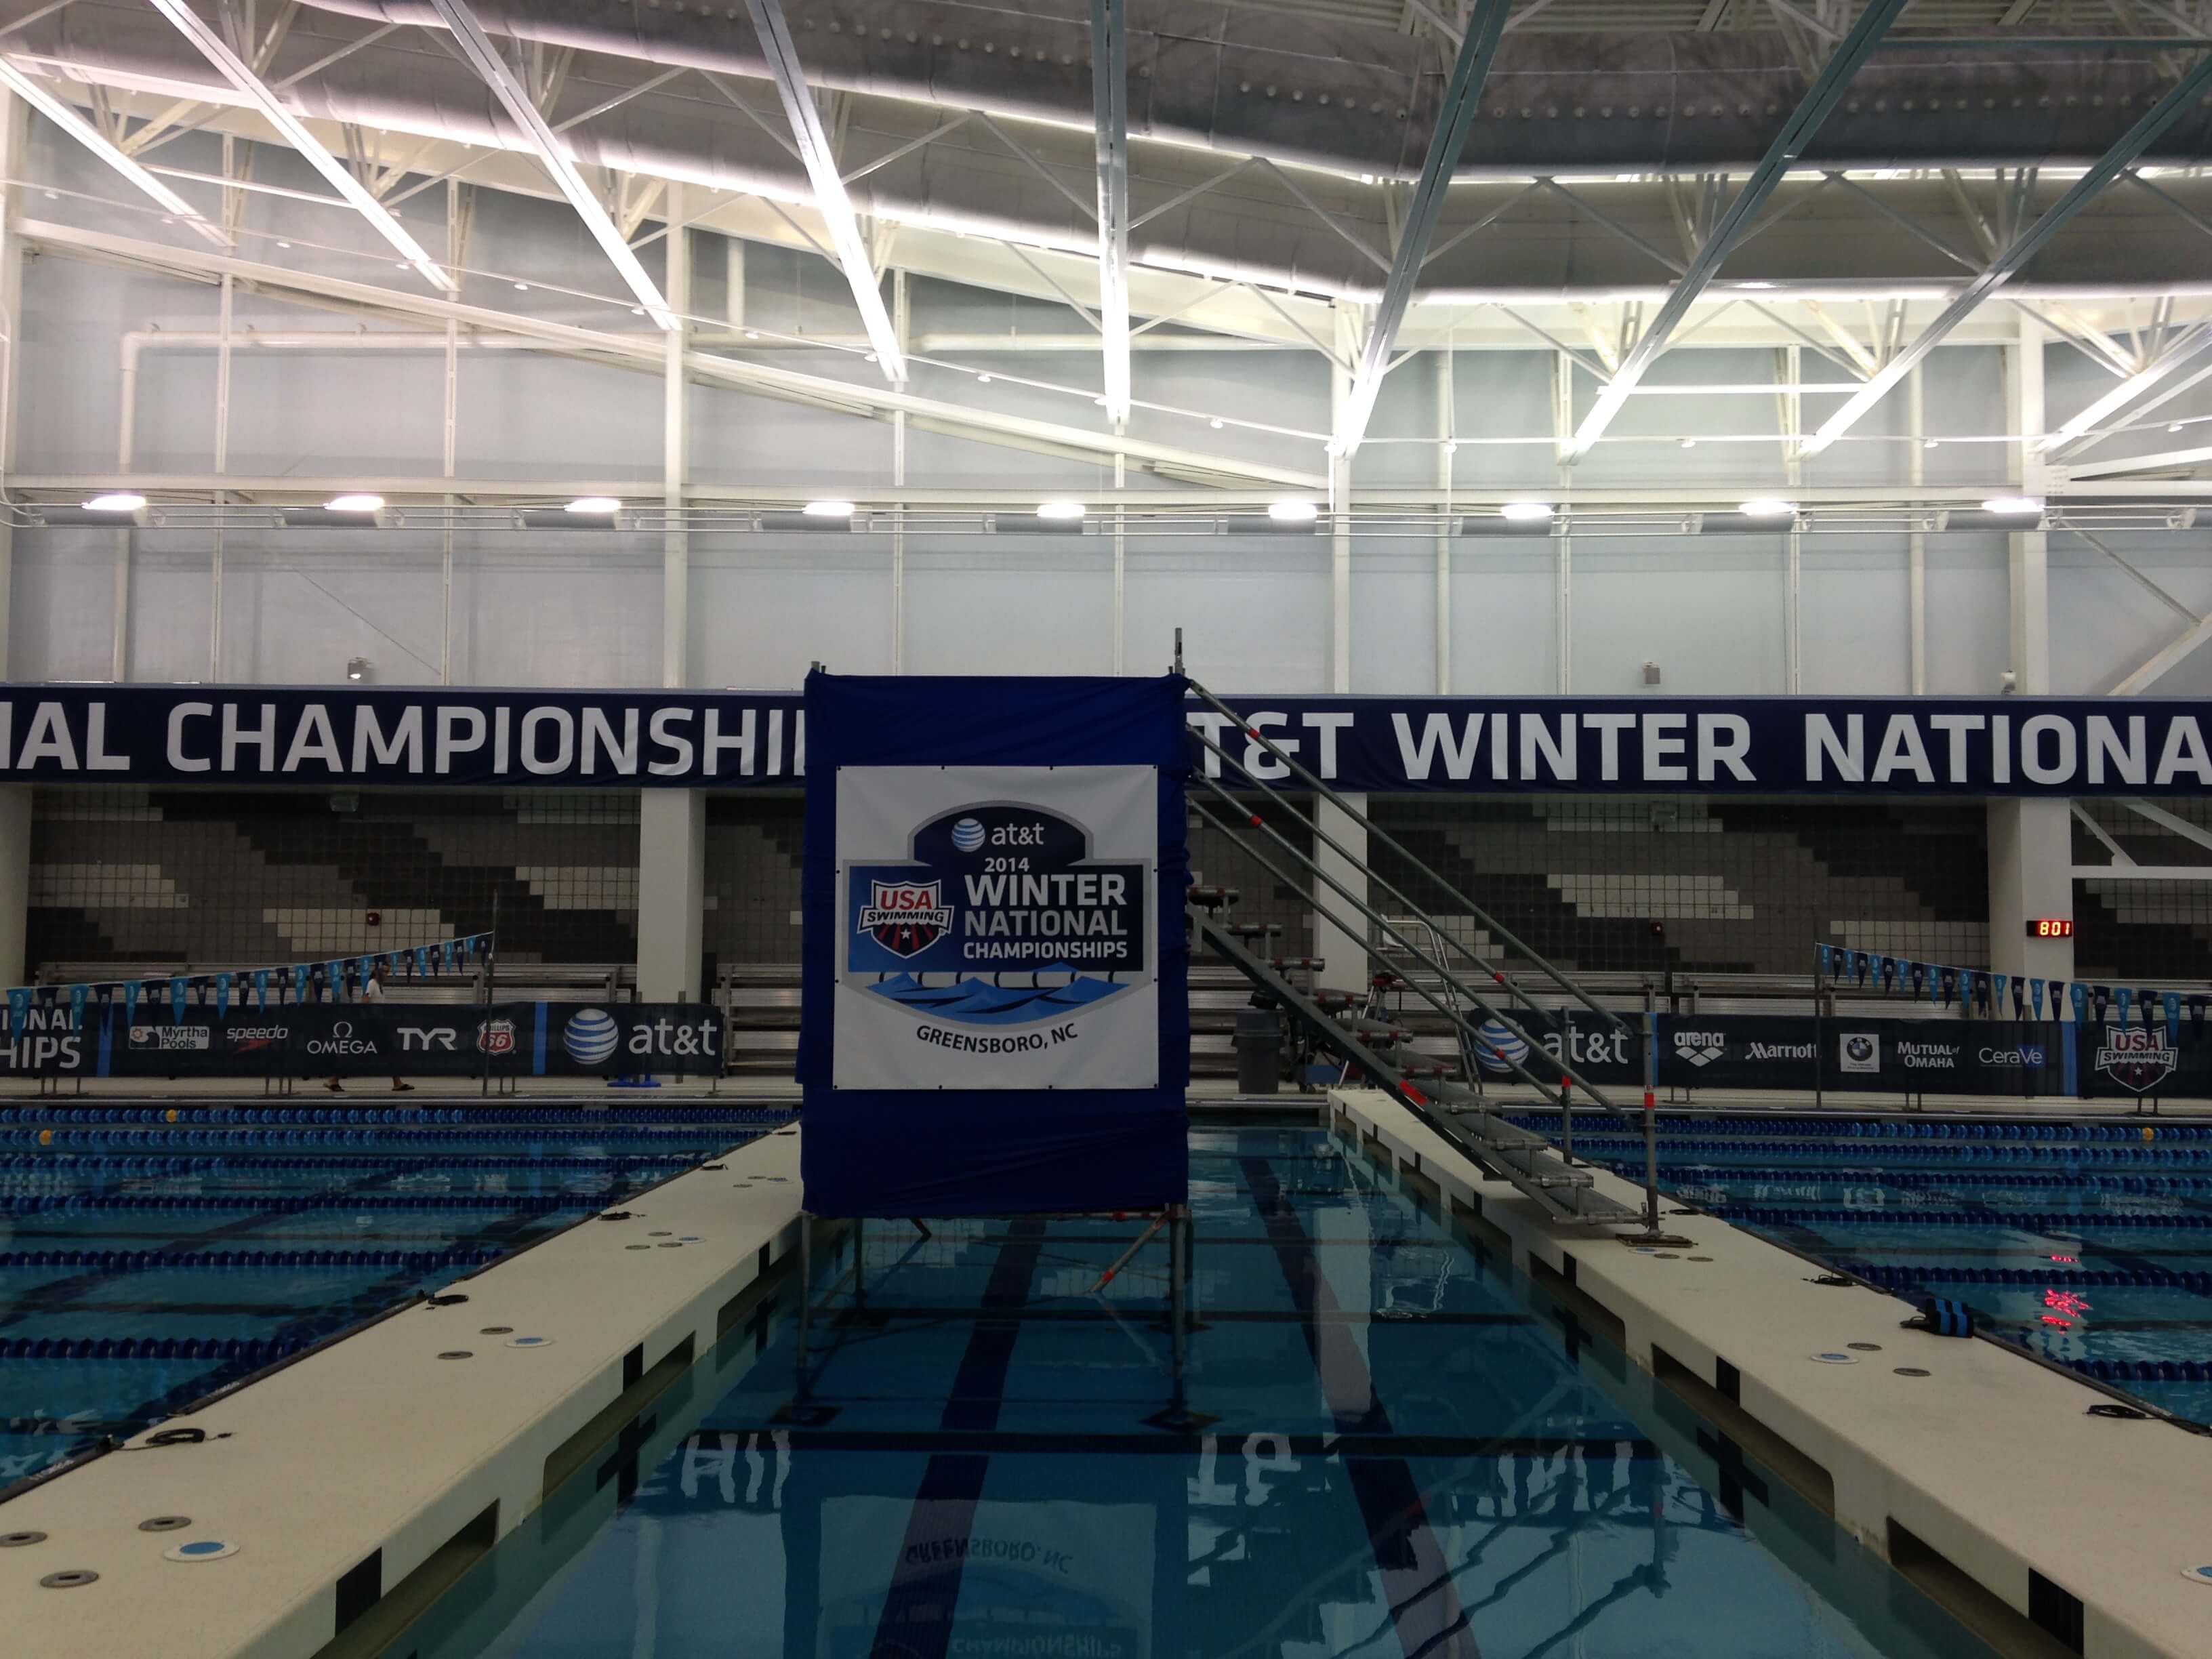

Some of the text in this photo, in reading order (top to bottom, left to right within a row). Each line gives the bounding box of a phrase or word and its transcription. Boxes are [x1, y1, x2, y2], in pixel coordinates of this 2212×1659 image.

[166, 702, 805, 776] CHAMPIONSHI
[1391, 712, 1757, 782] WINTER
[1805, 713, 2212, 785] NATIONA
[991, 823, 1044, 846] at&t
[984, 857, 1030, 872] 2014
[964, 874, 1128, 906] WINTER
[880, 890, 933, 910] USA
[867, 910, 944, 923] SWIMMING
[964, 910, 1128, 936] NATIONAL
[963, 941, 1128, 960] CHAMPIONSHIPS
[161, 1027, 208, 1040] Myrtha
[226, 1024, 288, 1042] speedo
[396, 1027, 455, 1050] TYR
[628, 1018, 718, 1055] at&t
[916, 1023, 1078, 1053] GREENSBORO, NC
[1674, 1031, 1724, 1047] arena
[161, 1039, 197, 1049] Pools
[307, 1039, 377, 1054] OMEGA
[2114, 1034, 2160, 1051] USA
[1904, 1054, 1955, 1068] OMAHA
[1978, 1048, 2043, 1064] CeraVe
[2104, 1051, 2171, 1062] SWIMMING
